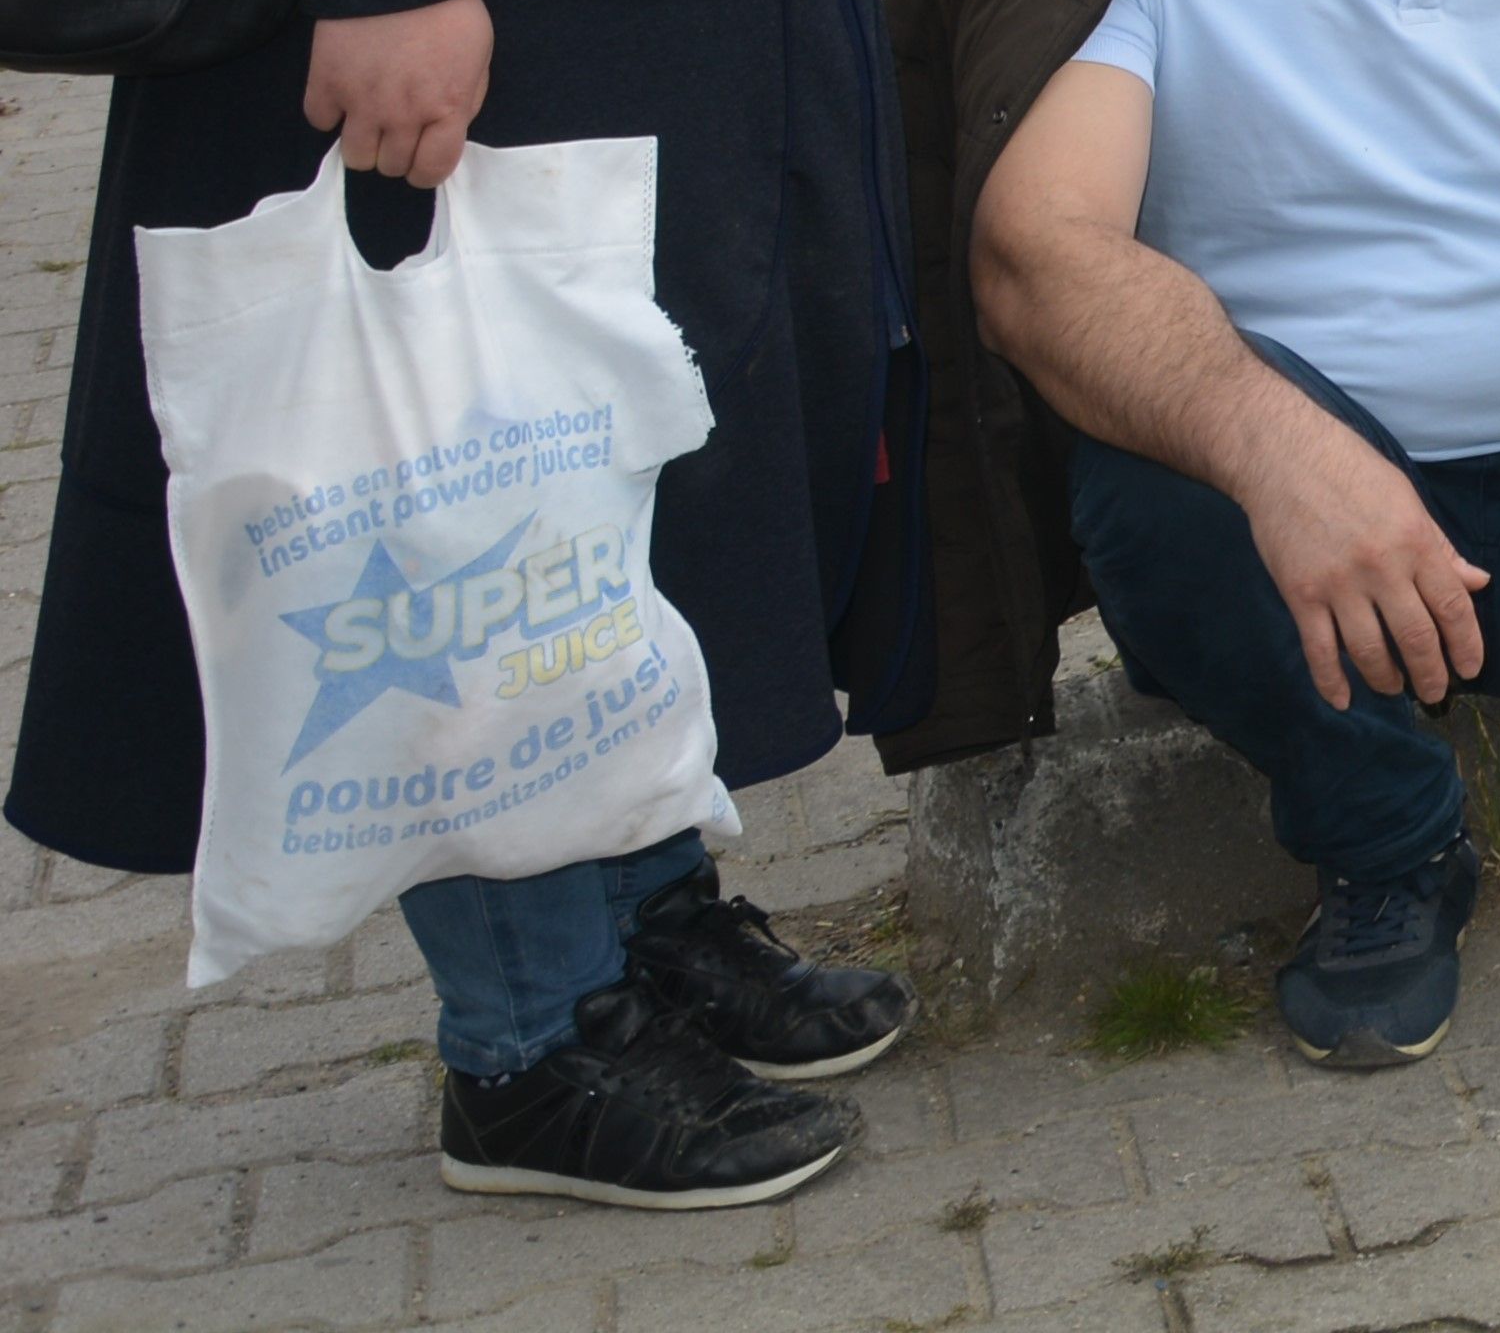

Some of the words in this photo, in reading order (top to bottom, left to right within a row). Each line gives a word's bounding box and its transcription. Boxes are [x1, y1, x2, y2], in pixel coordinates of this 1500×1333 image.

[244, 484, 346, 547] bebida
[352, 466, 391, 499] en
[395, 437, 482, 491] polvo
[488, 420, 533, 455] con
[534, 403, 613, 442] sabor!
[259, 497, 387, 578] instant
[392, 454, 528, 526] powder
[530, 435, 612, 488] juice!
[318, 522, 631, 677] SUPER
[495, 595, 645, 701] JUICE
[281, 820, 395, 856] bebida
[400, 751, 590, 841] aromatizada
[594, 719, 641, 758] em
[285, 756, 496, 826] poudre
[509, 715, 575, 771] de
[585, 640, 669, 739] jus!
